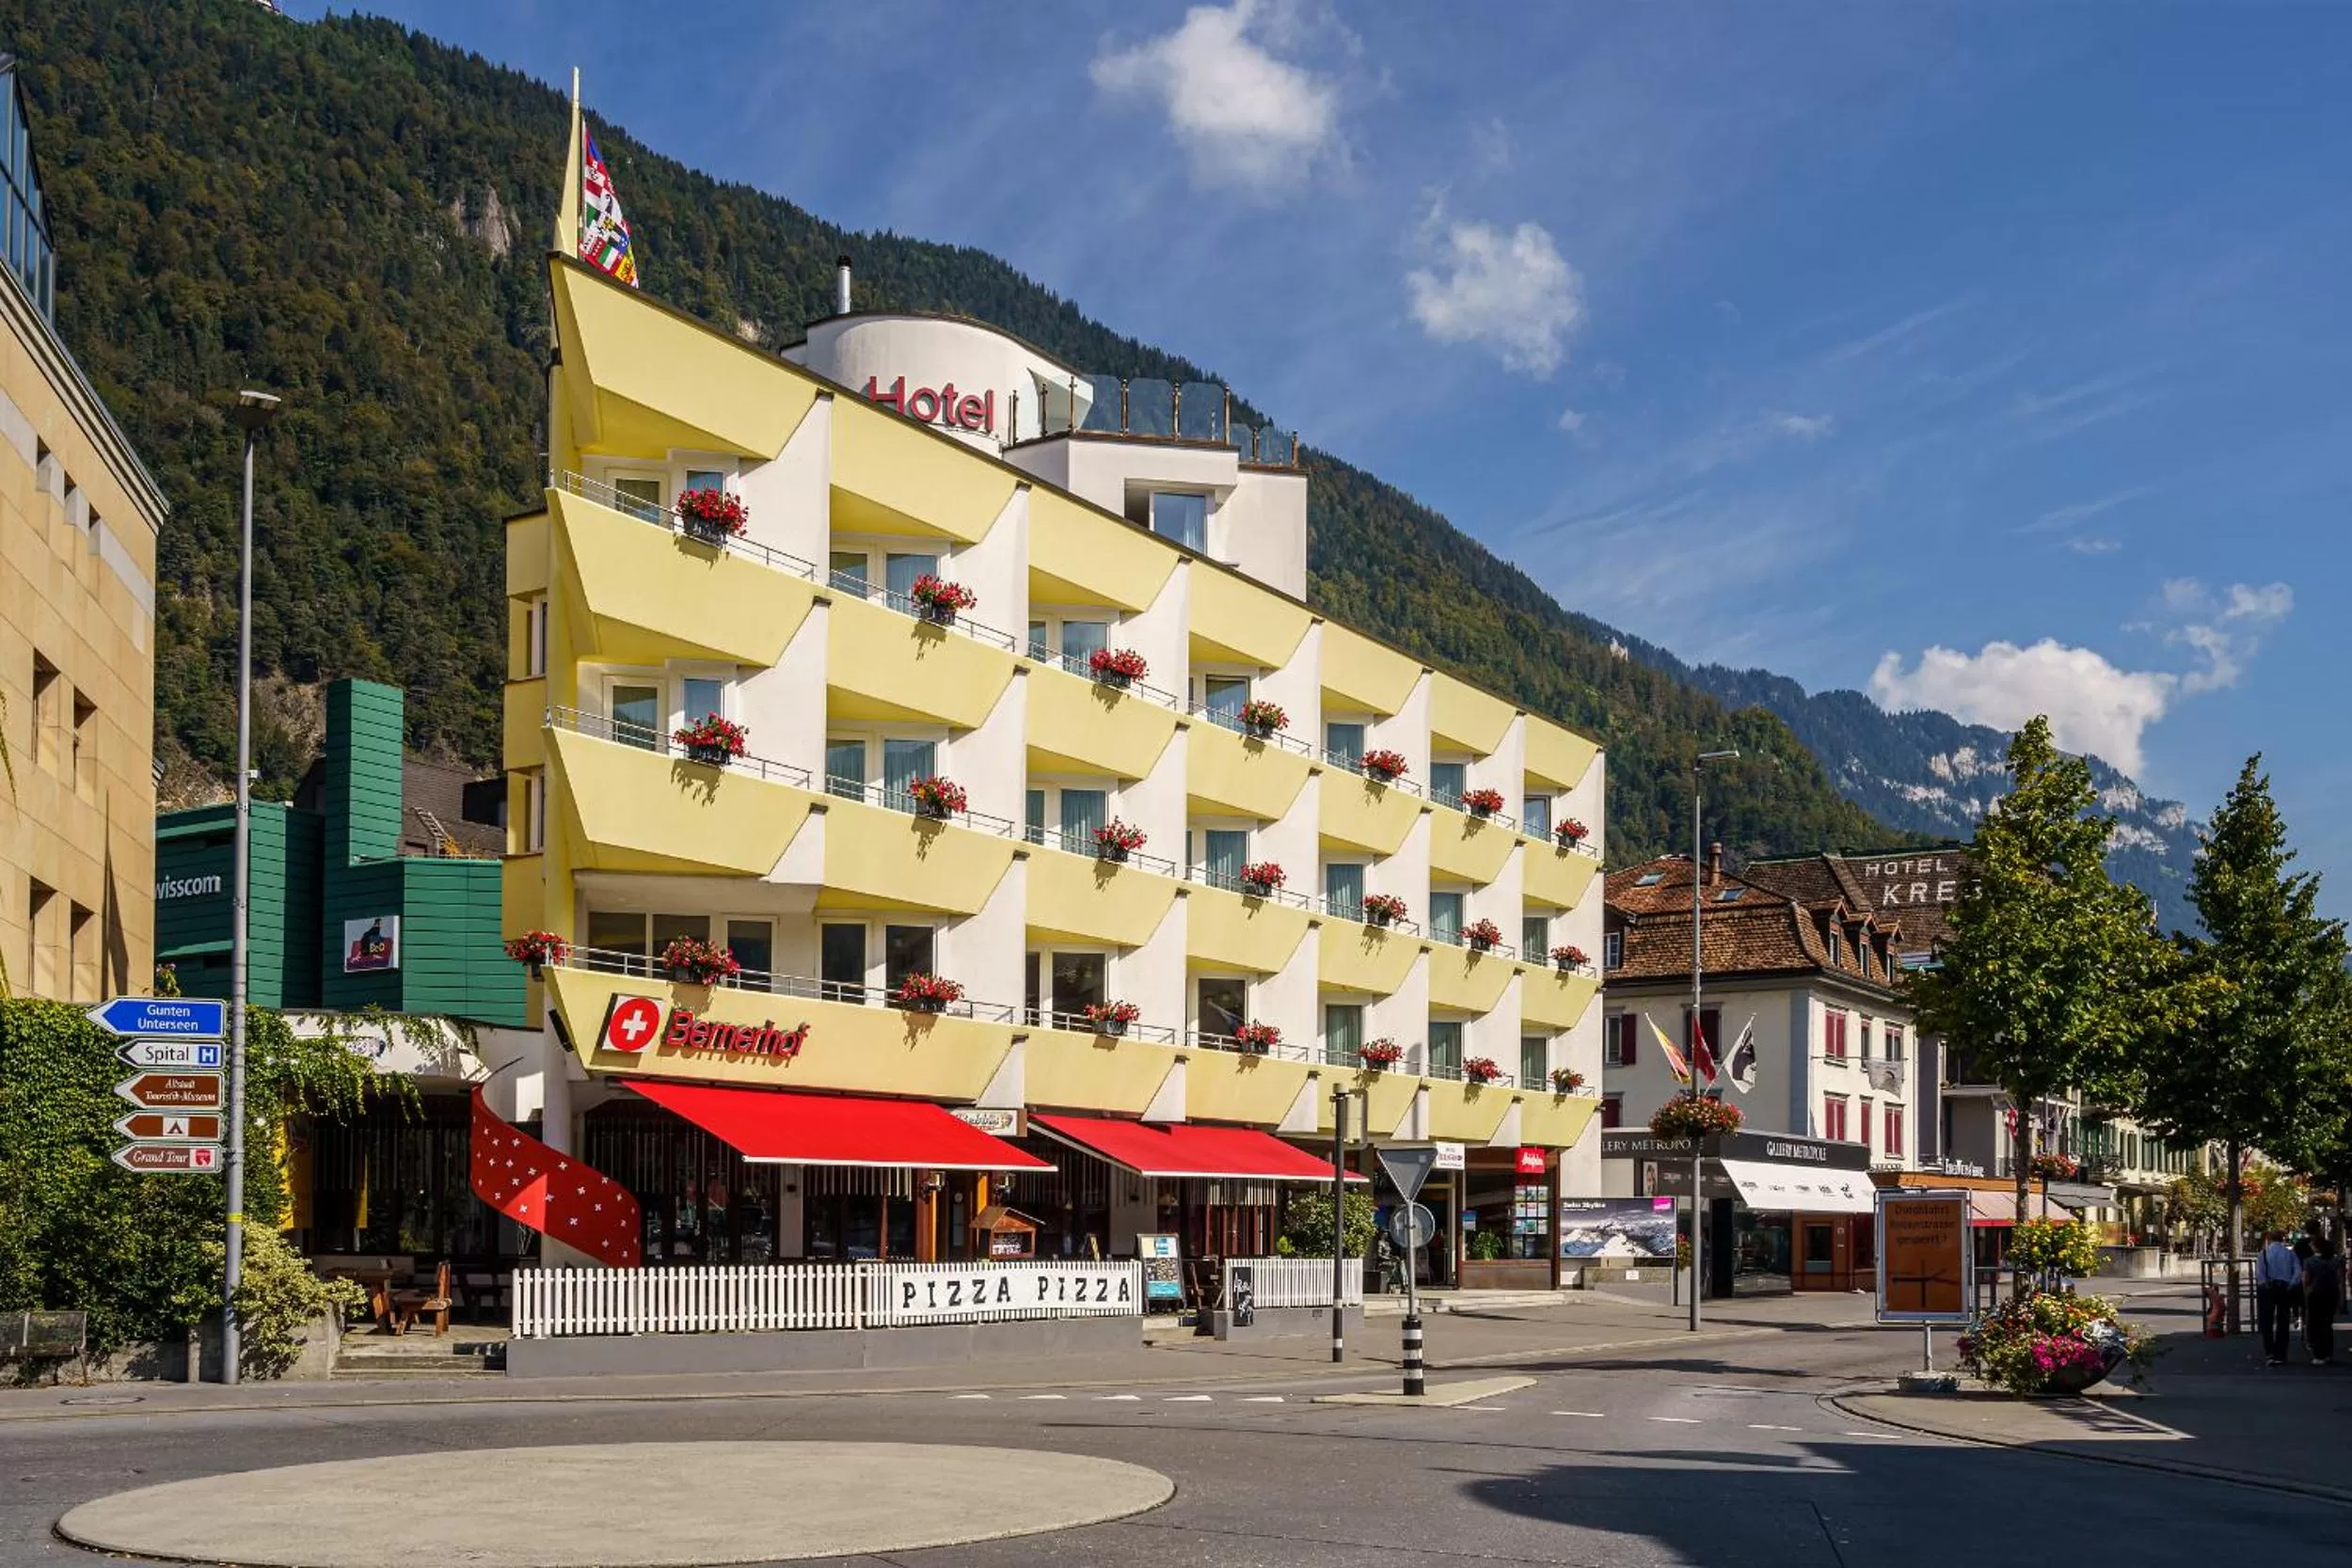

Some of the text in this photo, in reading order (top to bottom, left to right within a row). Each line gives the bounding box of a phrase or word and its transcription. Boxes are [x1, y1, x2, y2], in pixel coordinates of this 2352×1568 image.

[868, 375, 994, 434] Hotel
[1865, 858, 1949, 878] HOTEL
[1883, 879, 1983, 906] KRES
[147, 1005, 191, 1017] Gunten
[137, 1019, 199, 1031] Unterseen
[666, 1008, 810, 1057] Bernerhof
[145, 1046, 189, 1064] Spital
[133, 1151, 188, 1164] Grand Tour
[1793, 1144, 1826, 1161] METROPOLE
[902, 1276, 1011, 1308] PIZZA
